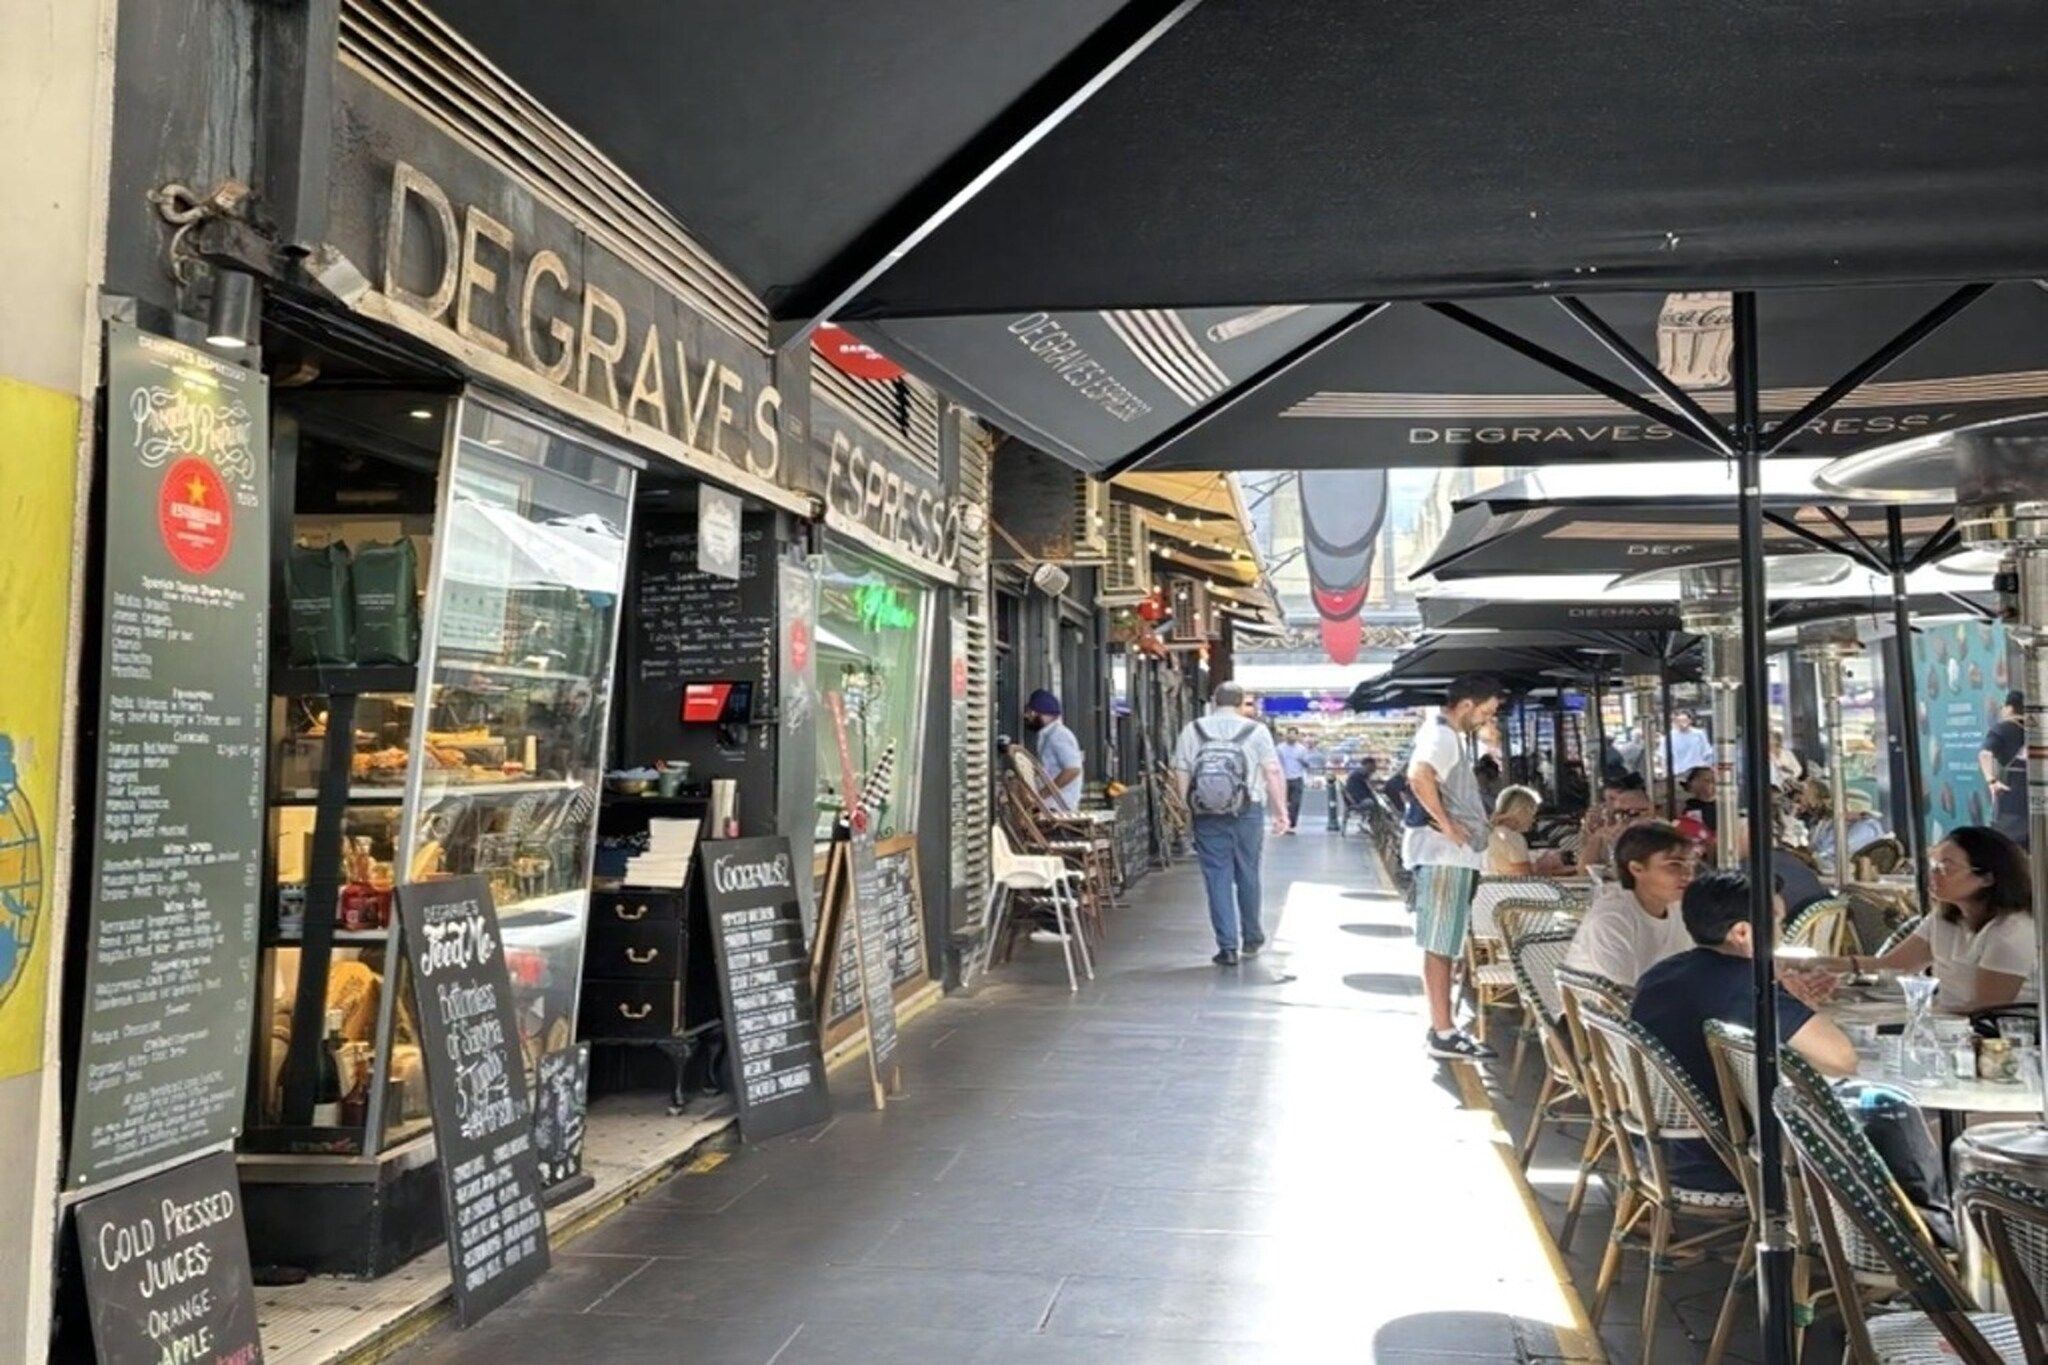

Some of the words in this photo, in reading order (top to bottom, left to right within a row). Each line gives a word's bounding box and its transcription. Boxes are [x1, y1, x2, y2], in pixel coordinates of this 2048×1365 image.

[384, 160, 783, 481] DEGRAVES
[1008, 312, 1105, 387] DEGRAVES
[1408, 424, 1673, 445] DEGRAVES
[826, 430, 961, 568] ESPRESSO
[100, 1218, 155, 1272] COLD
[161, 1190, 234, 1241] PRESSED
